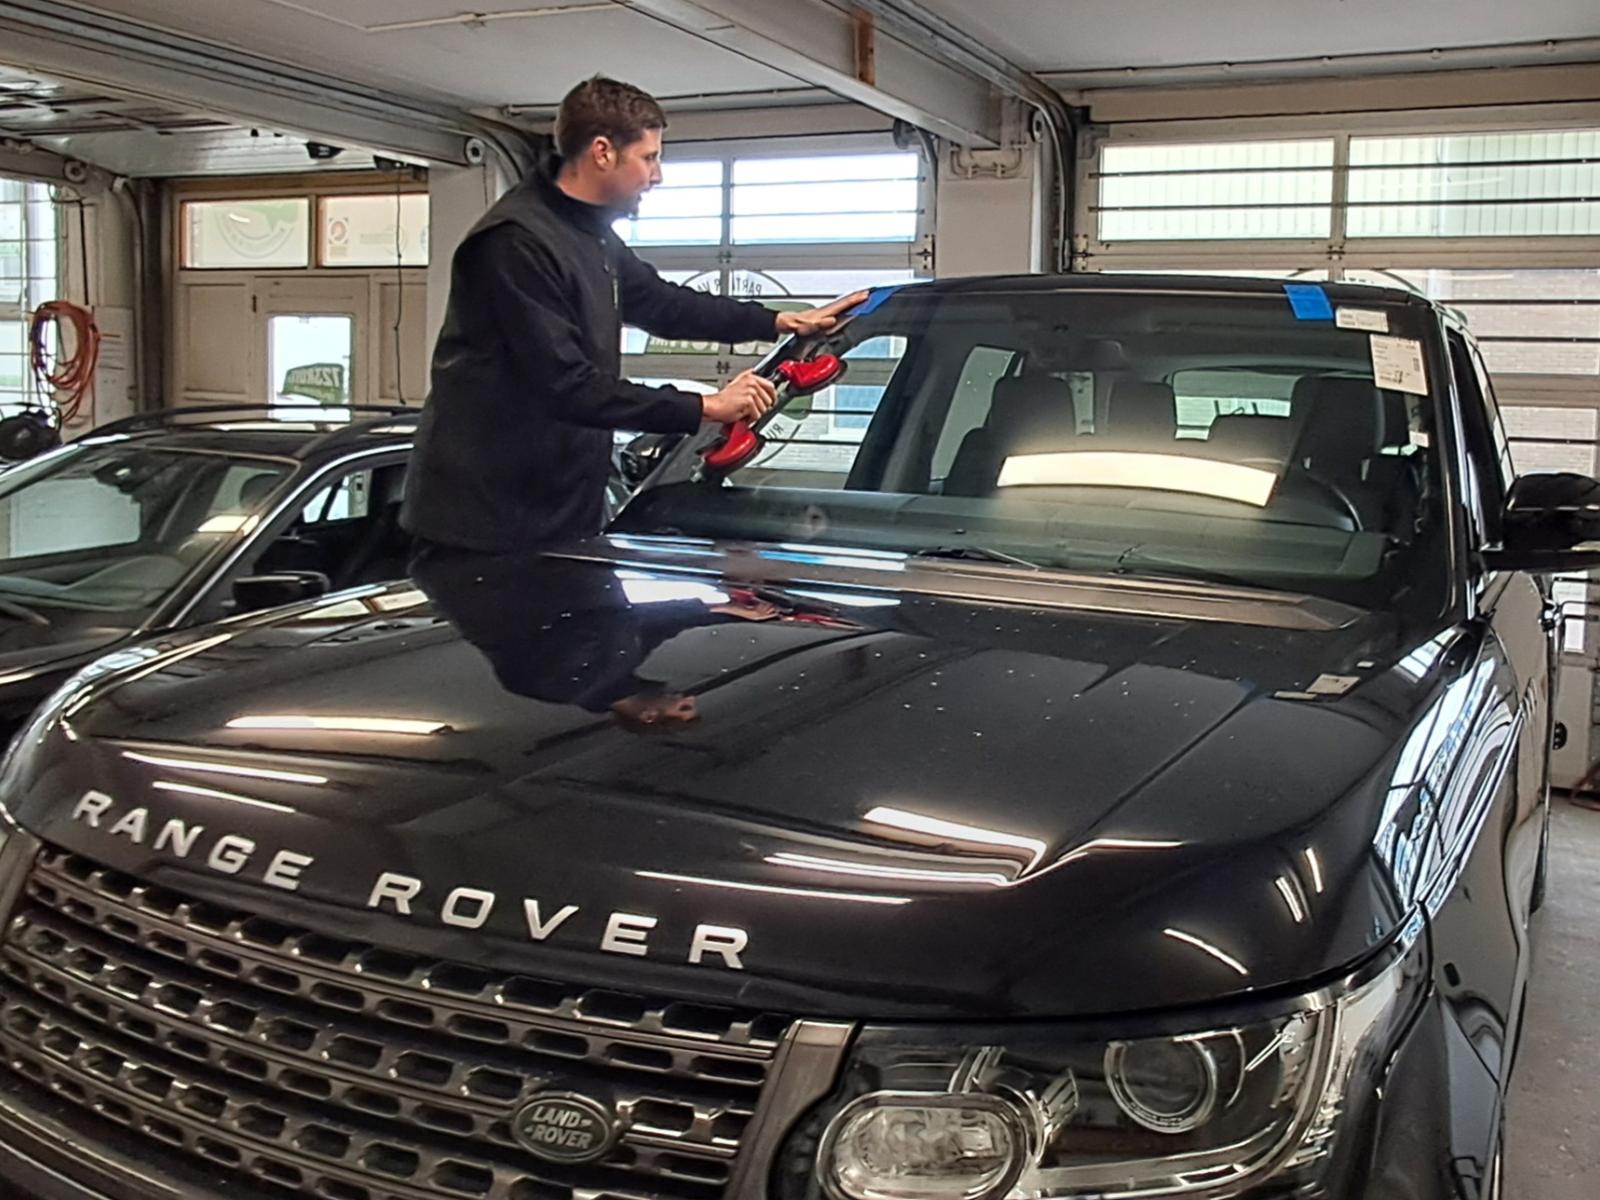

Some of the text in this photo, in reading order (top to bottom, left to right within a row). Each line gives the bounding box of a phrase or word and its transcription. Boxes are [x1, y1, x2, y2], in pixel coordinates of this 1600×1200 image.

[72, 789, 749, 969] RANGE ROVER
[532, 1105, 582, 1128] LAND
[531, 1124, 593, 1149] ROVER
